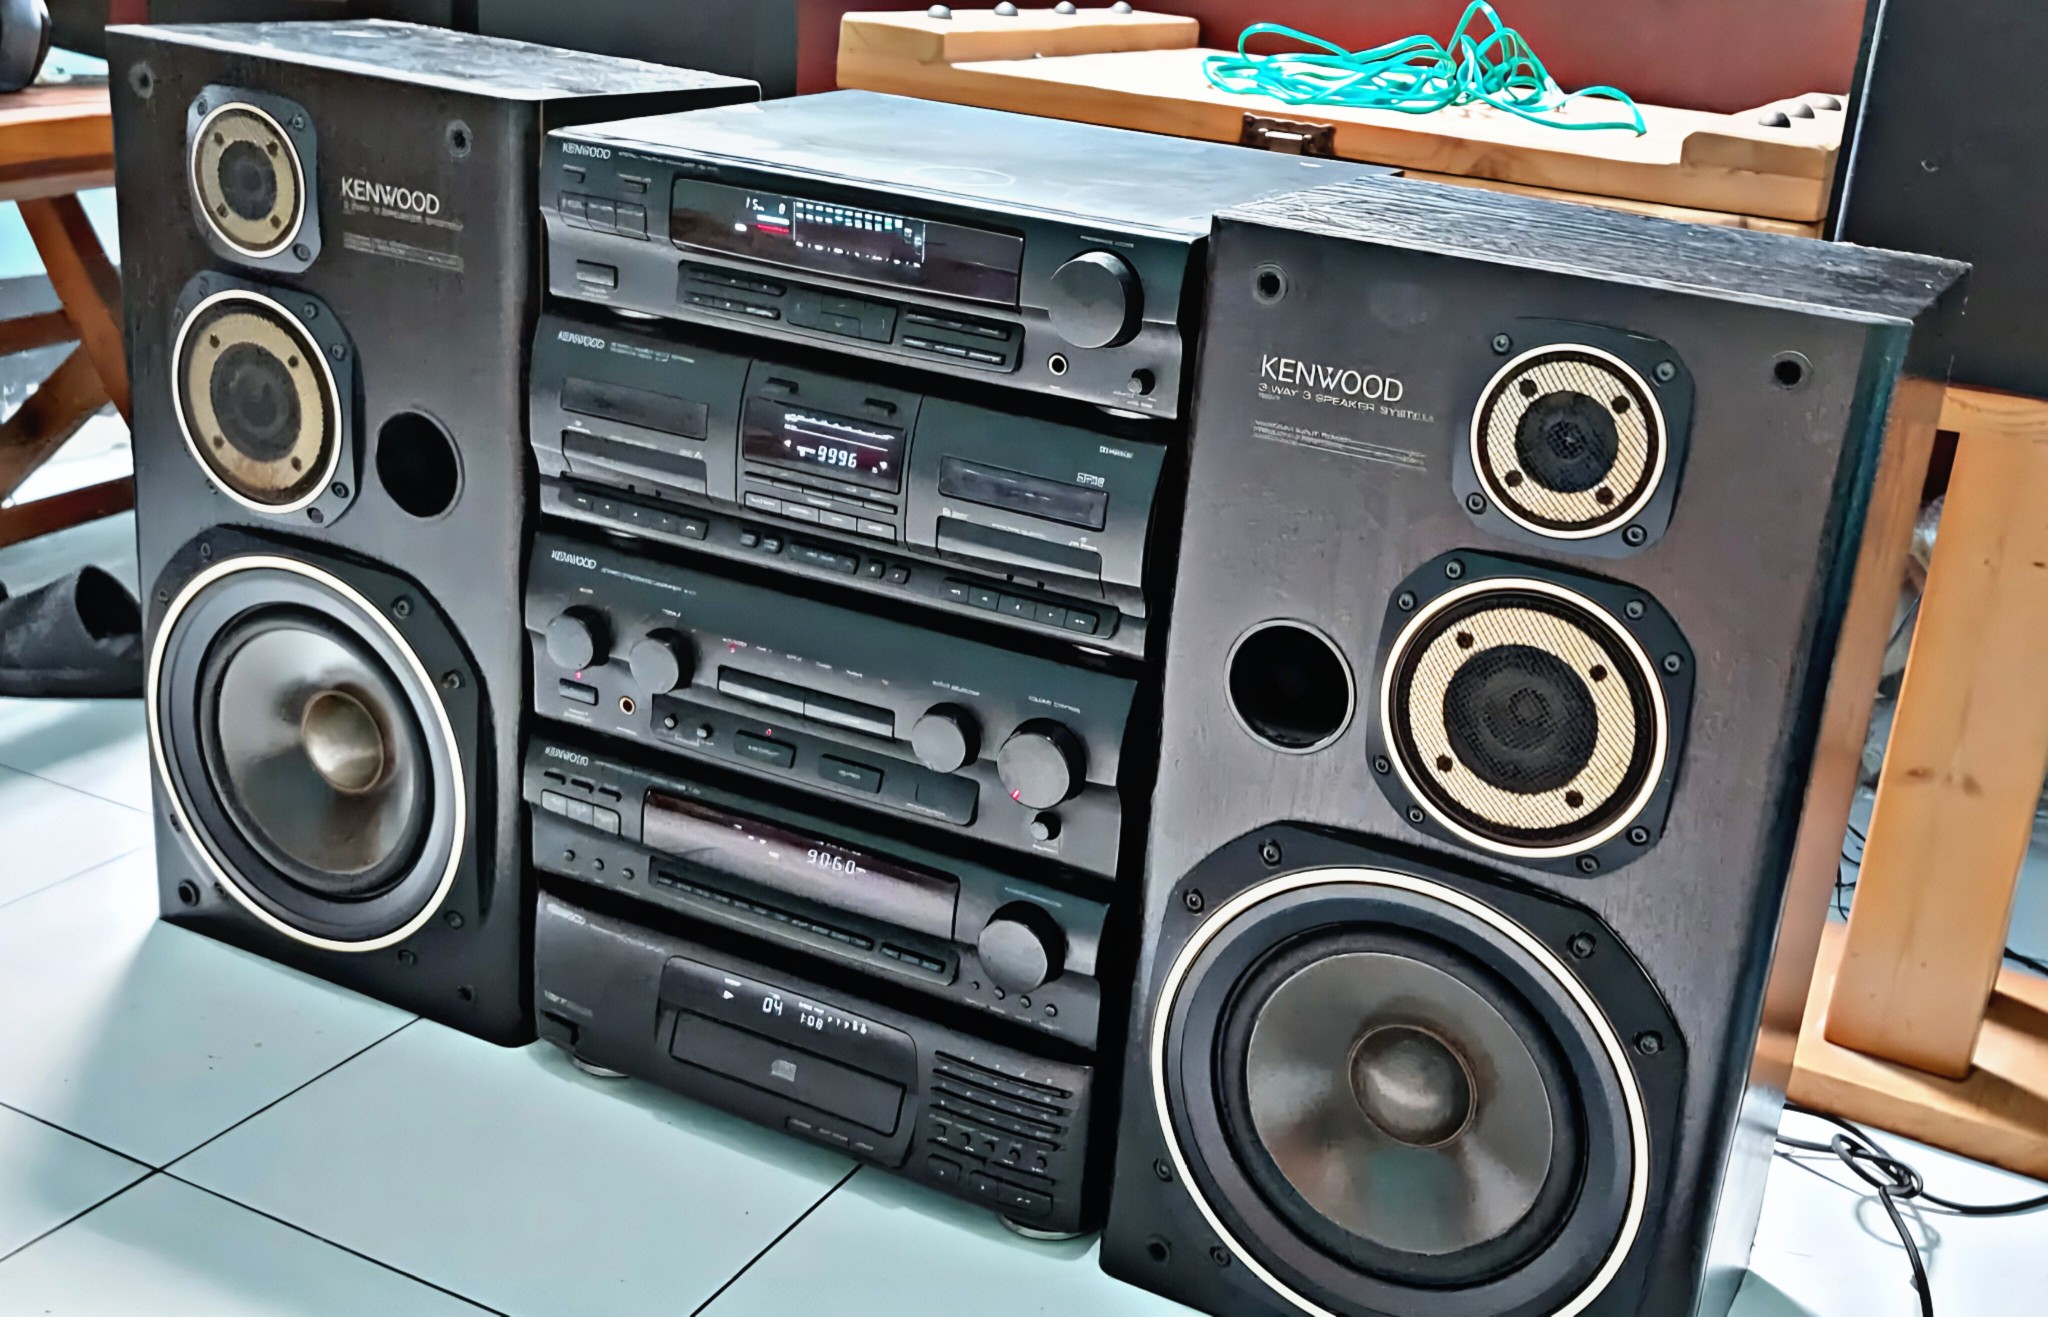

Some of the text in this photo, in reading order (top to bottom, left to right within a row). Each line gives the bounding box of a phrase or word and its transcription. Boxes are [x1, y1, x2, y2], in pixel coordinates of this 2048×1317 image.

[341, 176, 440, 215] KENWOOD
[1258, 382, 1268, 392] 3
[1271, 385, 1299, 397] WAY
[1302, 390, 1312, 400] 3
[1315, 393, 1375, 412] SPEAKER
[1261, 354, 1404, 402] KENWOOD
